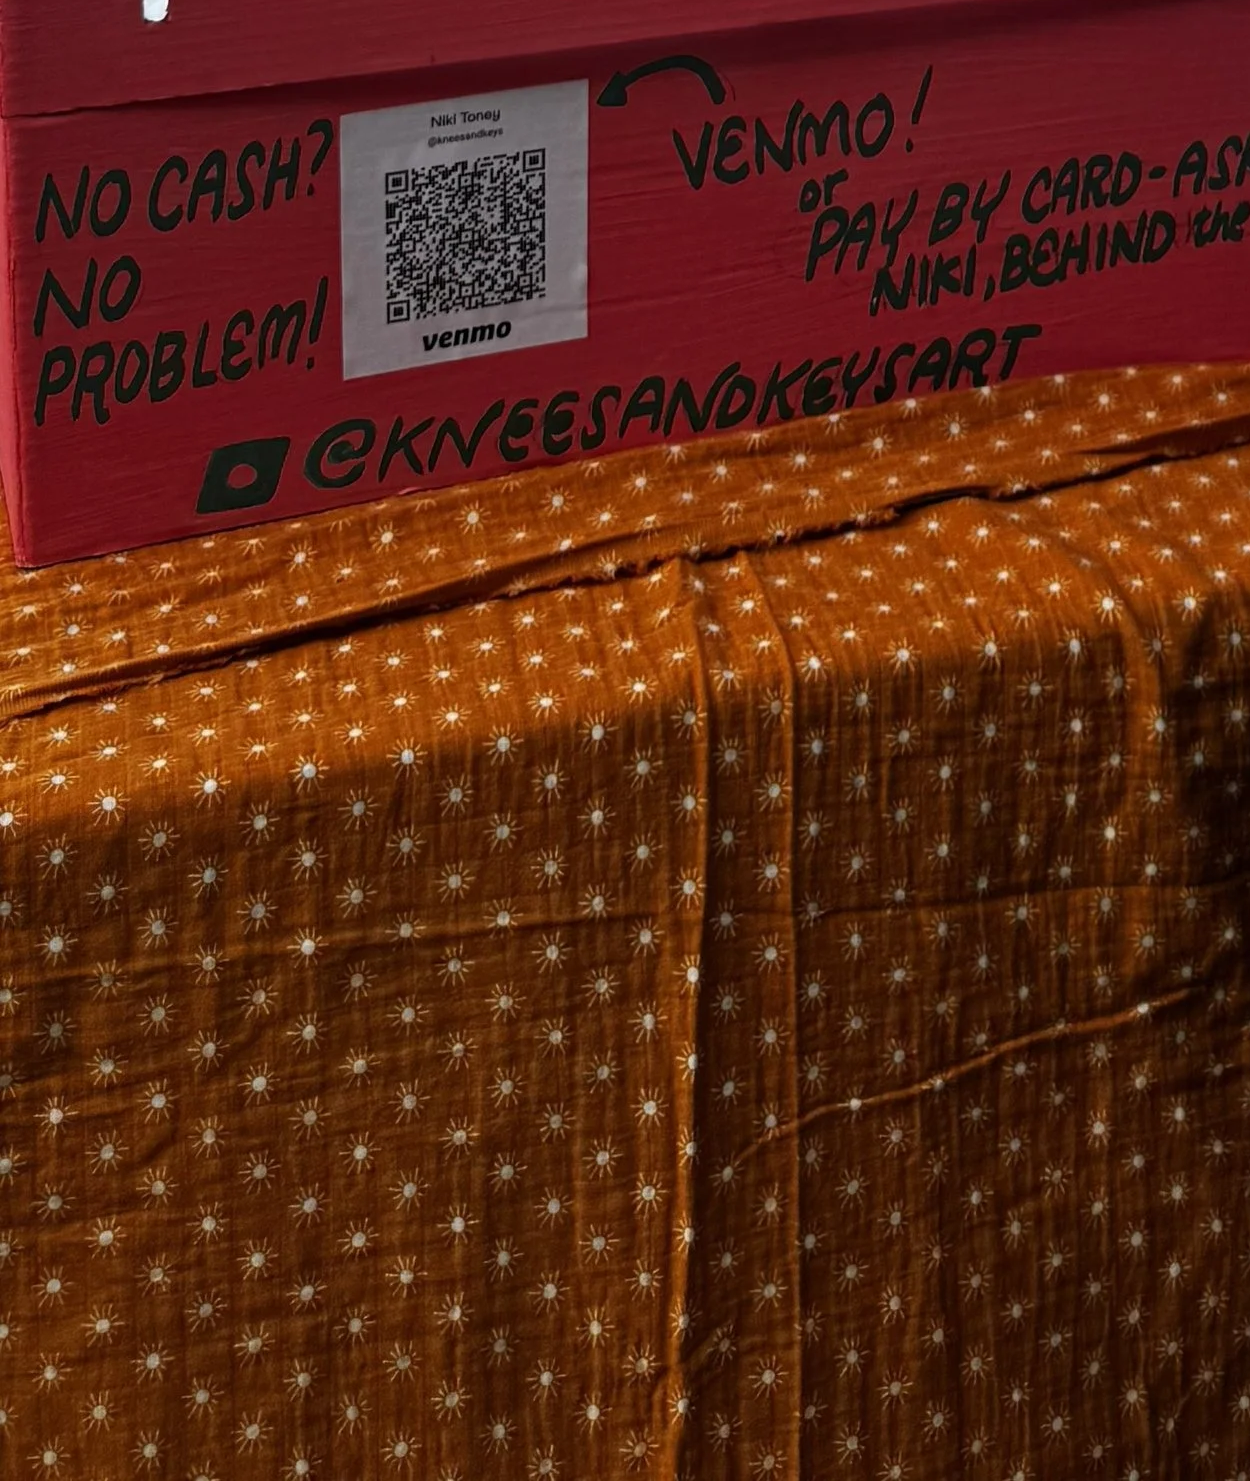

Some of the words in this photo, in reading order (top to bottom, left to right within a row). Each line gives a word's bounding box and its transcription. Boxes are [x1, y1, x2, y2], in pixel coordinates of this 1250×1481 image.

[431, 113, 456, 127] Niki
[460, 109, 501, 123] Toney
[672, 64, 933, 191] VENMO!
[35, 163, 132, 243] NO
[147, 118, 335, 232] CASH?
[800, 169, 849, 213] or
[804, 190, 920, 282] PAY
[928, 170, 1011, 245] BY
[33, 254, 142, 337] NO
[999, 210, 1176, 294] BEHIND
[34, 276, 329, 427] PROBLEM!
[421, 318, 512, 353] venmo
[303, 324, 1042, 490] @KNEESANDKEYSART
